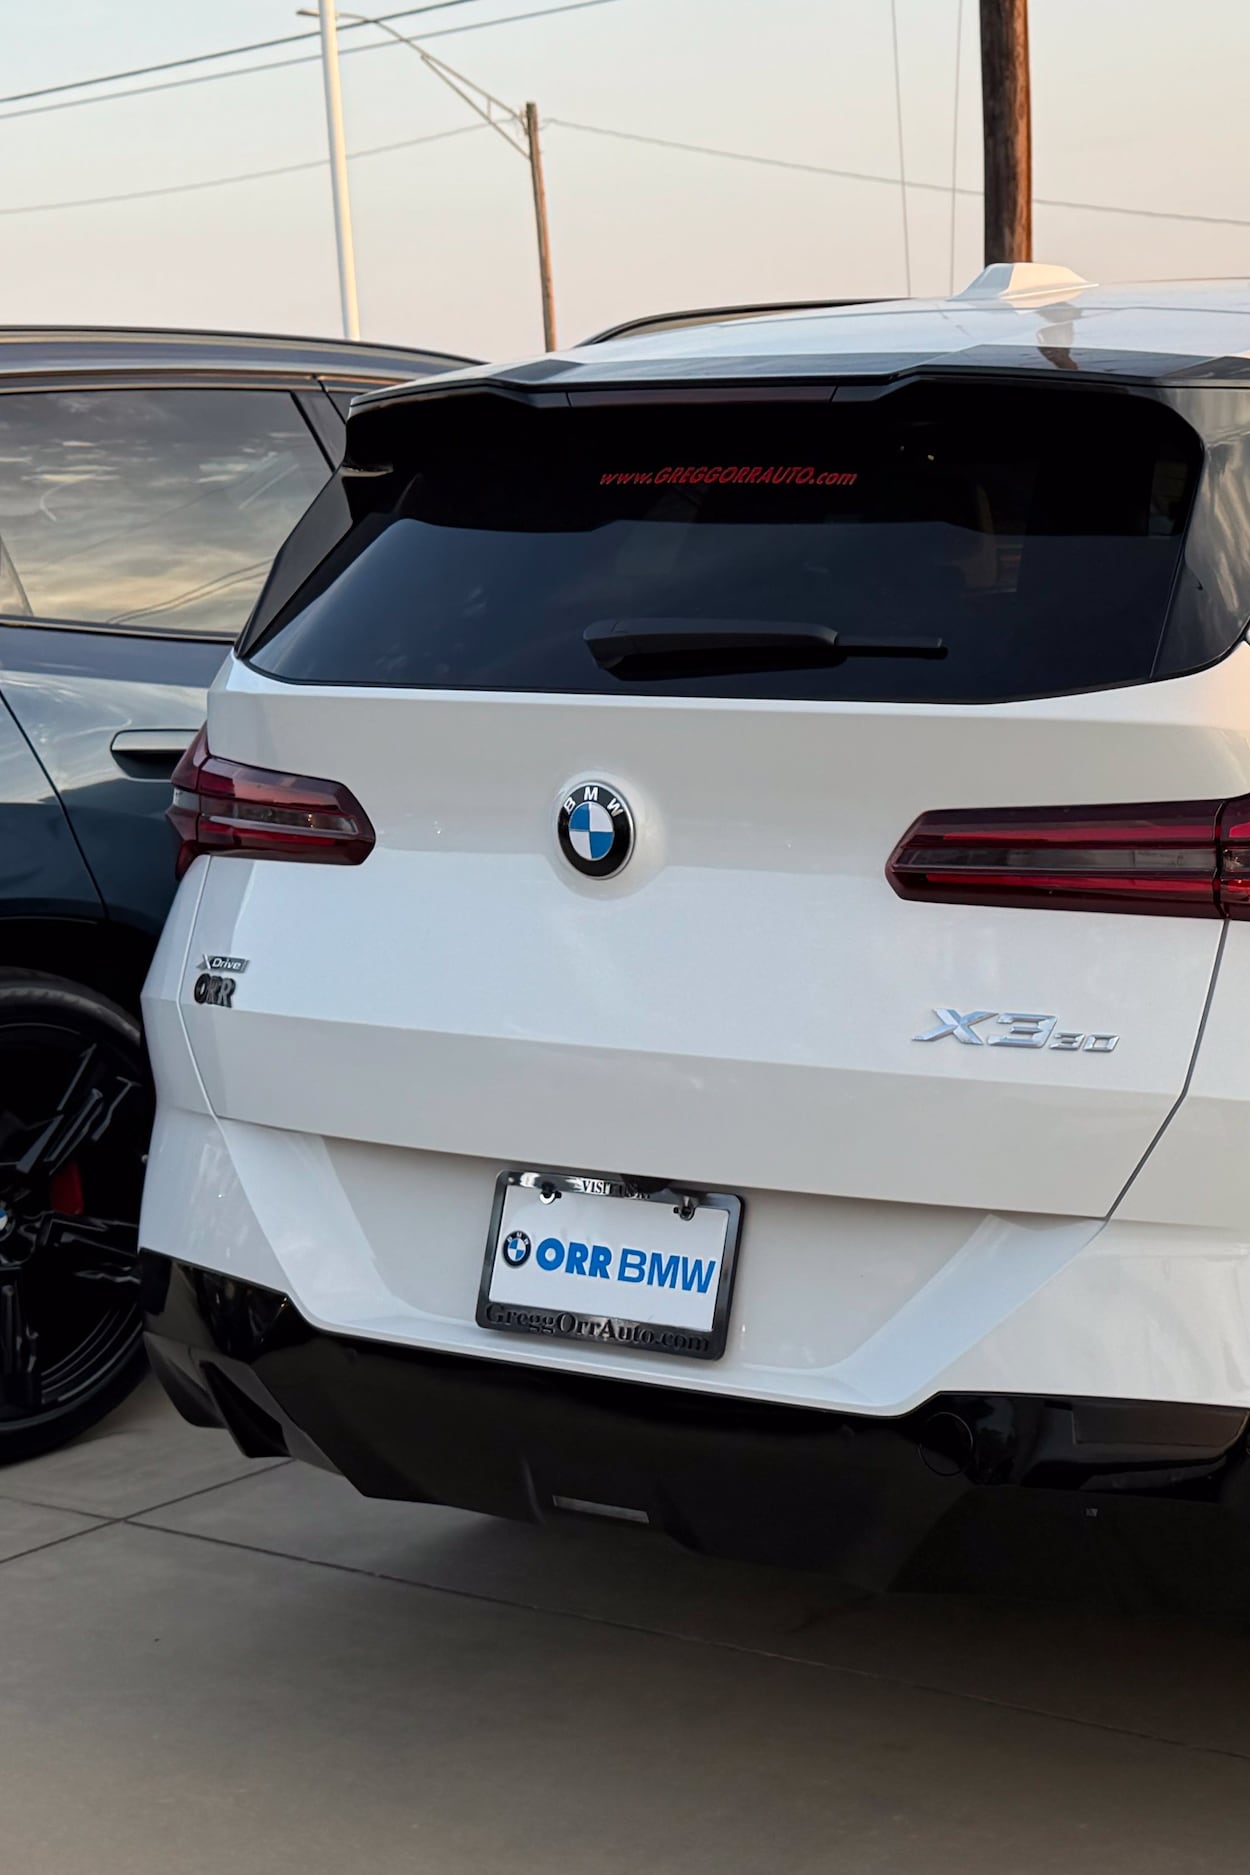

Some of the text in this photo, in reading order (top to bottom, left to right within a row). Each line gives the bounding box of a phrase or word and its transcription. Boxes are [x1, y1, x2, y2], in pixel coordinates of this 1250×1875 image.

[600, 466, 858, 485] www.GREGGORRAUTO.com
[563, 786, 624, 817] BMW
[194, 973, 236, 1008] ORR
[535, 1237, 716, 1293] ORR BMW
[485, 1303, 710, 1352] GreggOrrAuto.com
